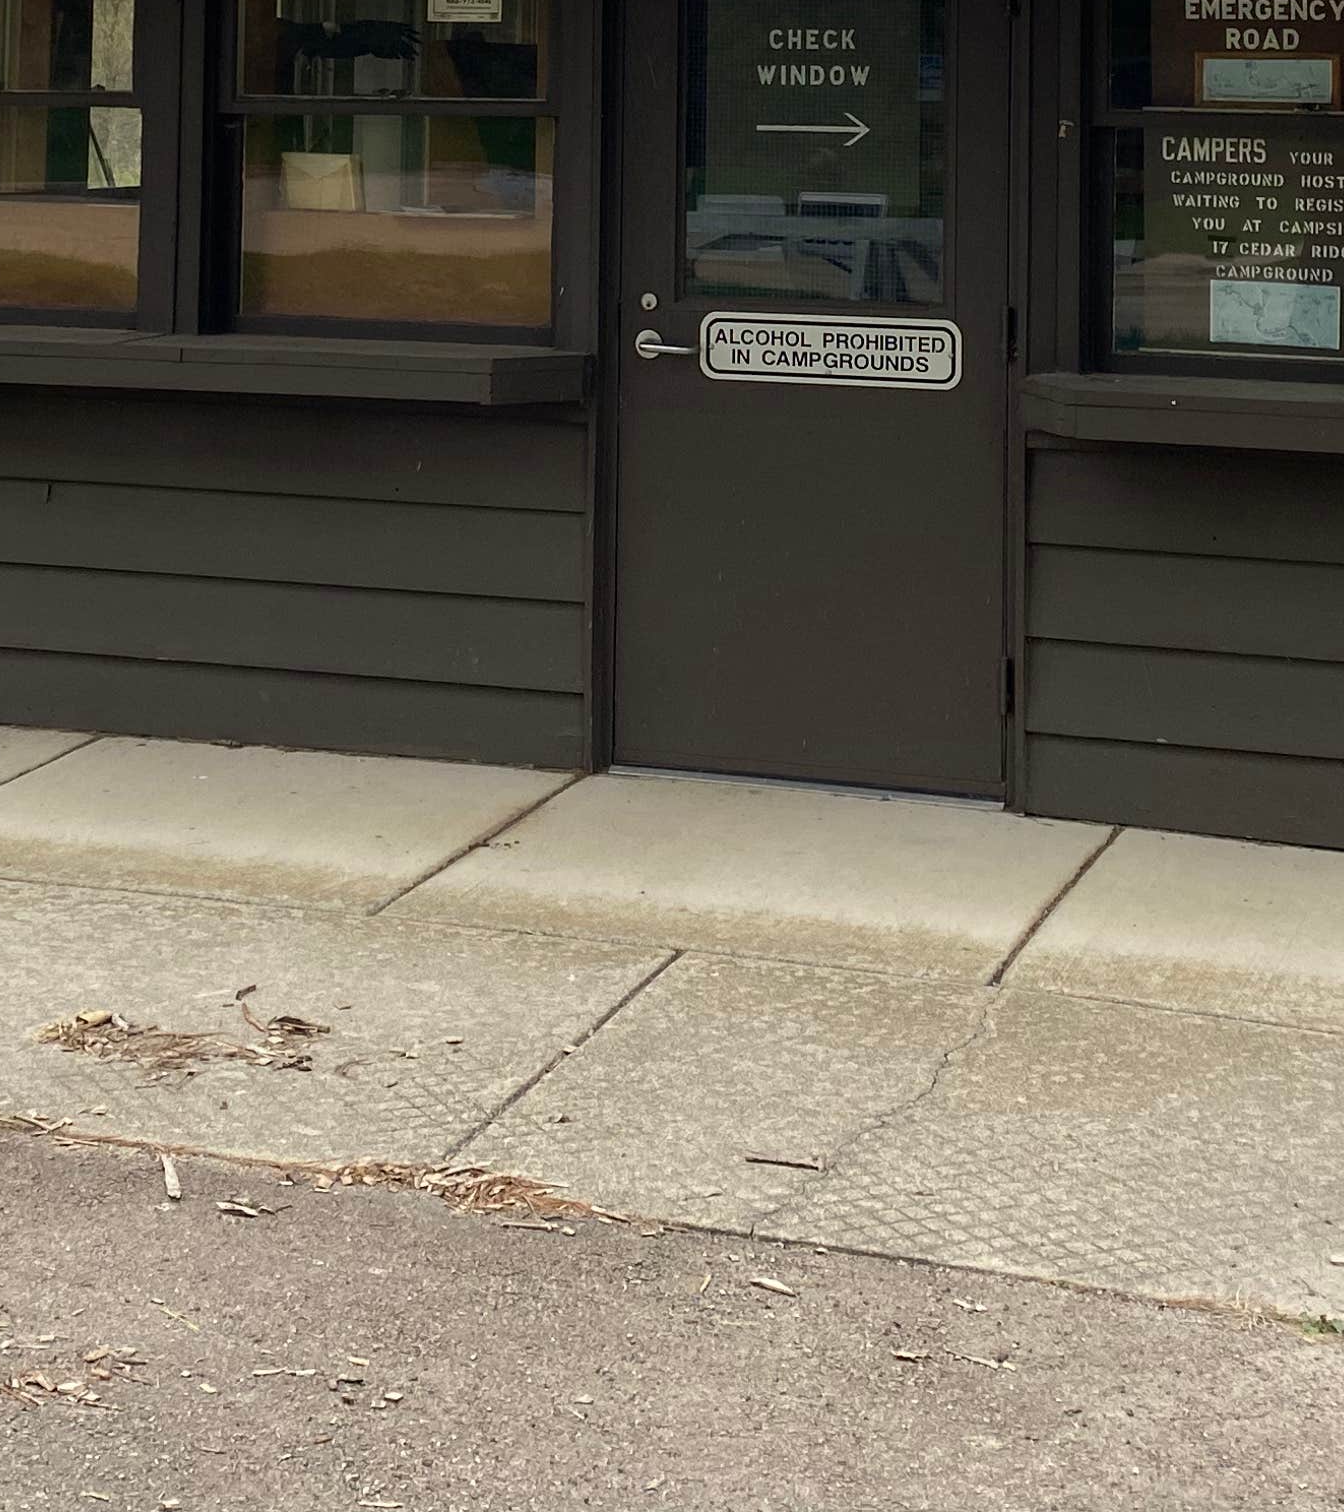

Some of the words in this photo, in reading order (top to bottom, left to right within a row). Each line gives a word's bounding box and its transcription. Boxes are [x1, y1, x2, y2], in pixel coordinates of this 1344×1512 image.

[770, 29, 855, 49] CHECK
[1226, 28, 1299, 49] ROAD
[758, 65, 869, 85] WINDOW
[1163, 137, 1266, 163] CAMPERS
[1290, 152, 1332, 165] YOUR
[1172, 171, 1284, 186] CAMPGROUND
[1302, 175, 1344, 188] HOST
[1173, 195, 1239, 208] WAITING
[1256, 197, 1277, 209] TO
[1193, 218, 1224, 230] YOU
[1243, 220, 1261, 232] AT
[1214, 241, 1228, 254] 17
[1240, 243, 1295, 256] CEDAR
[1215, 264, 1334, 283] CAMPGROUND
[714, 329, 813, 349] ALCOHOL
[822, 331, 946, 354] PROHIBITED
[731, 348, 751, 365] IN
[761, 349, 930, 373] CAMPGROUNDS
